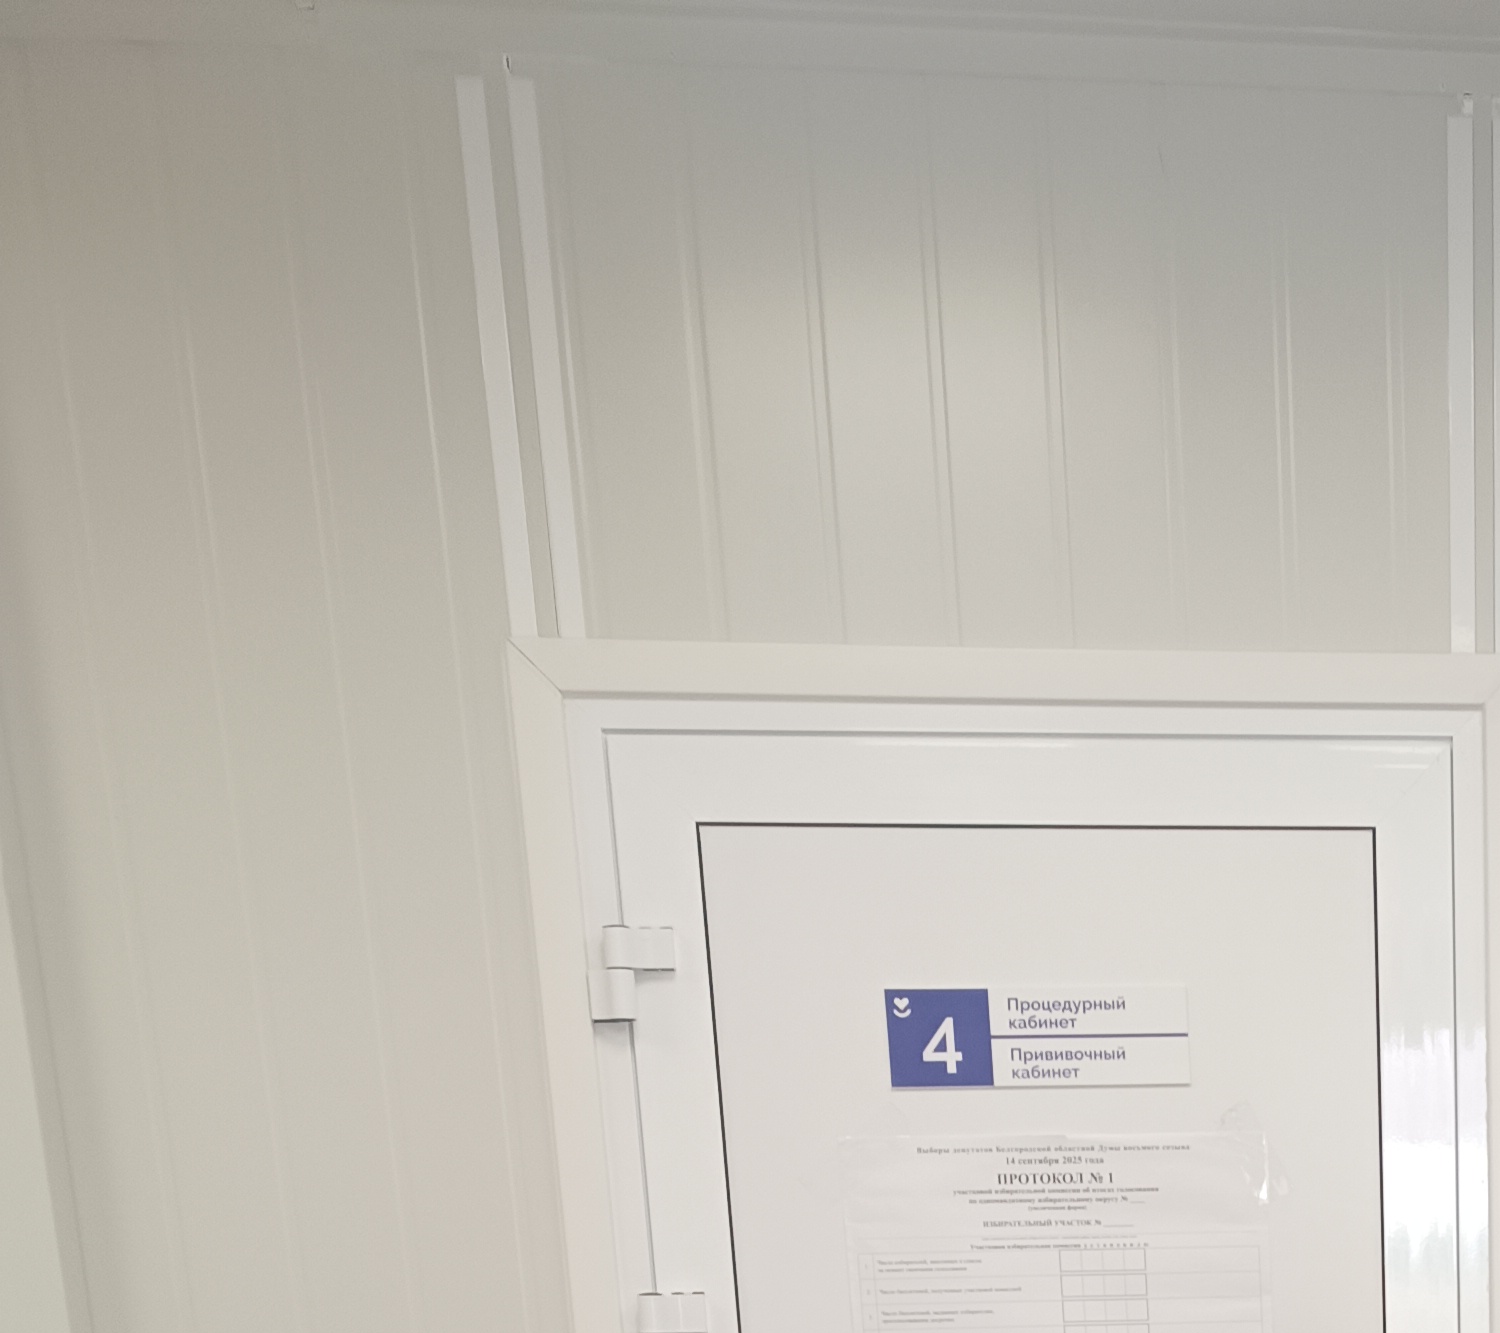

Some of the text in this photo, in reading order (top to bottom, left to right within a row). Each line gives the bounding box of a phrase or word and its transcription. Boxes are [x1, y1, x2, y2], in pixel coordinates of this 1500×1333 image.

[1007, 996, 1126, 1015] Процедурный
[1009, 1014, 1077, 1030] кабинет
[922, 1016, 963, 1074] 4
[1010, 1046, 1126, 1063] Прививочный
[1012, 1064, 1080, 1080] кабинет
[997, 1172, 1084, 1185] ПРОТОКОЛ
